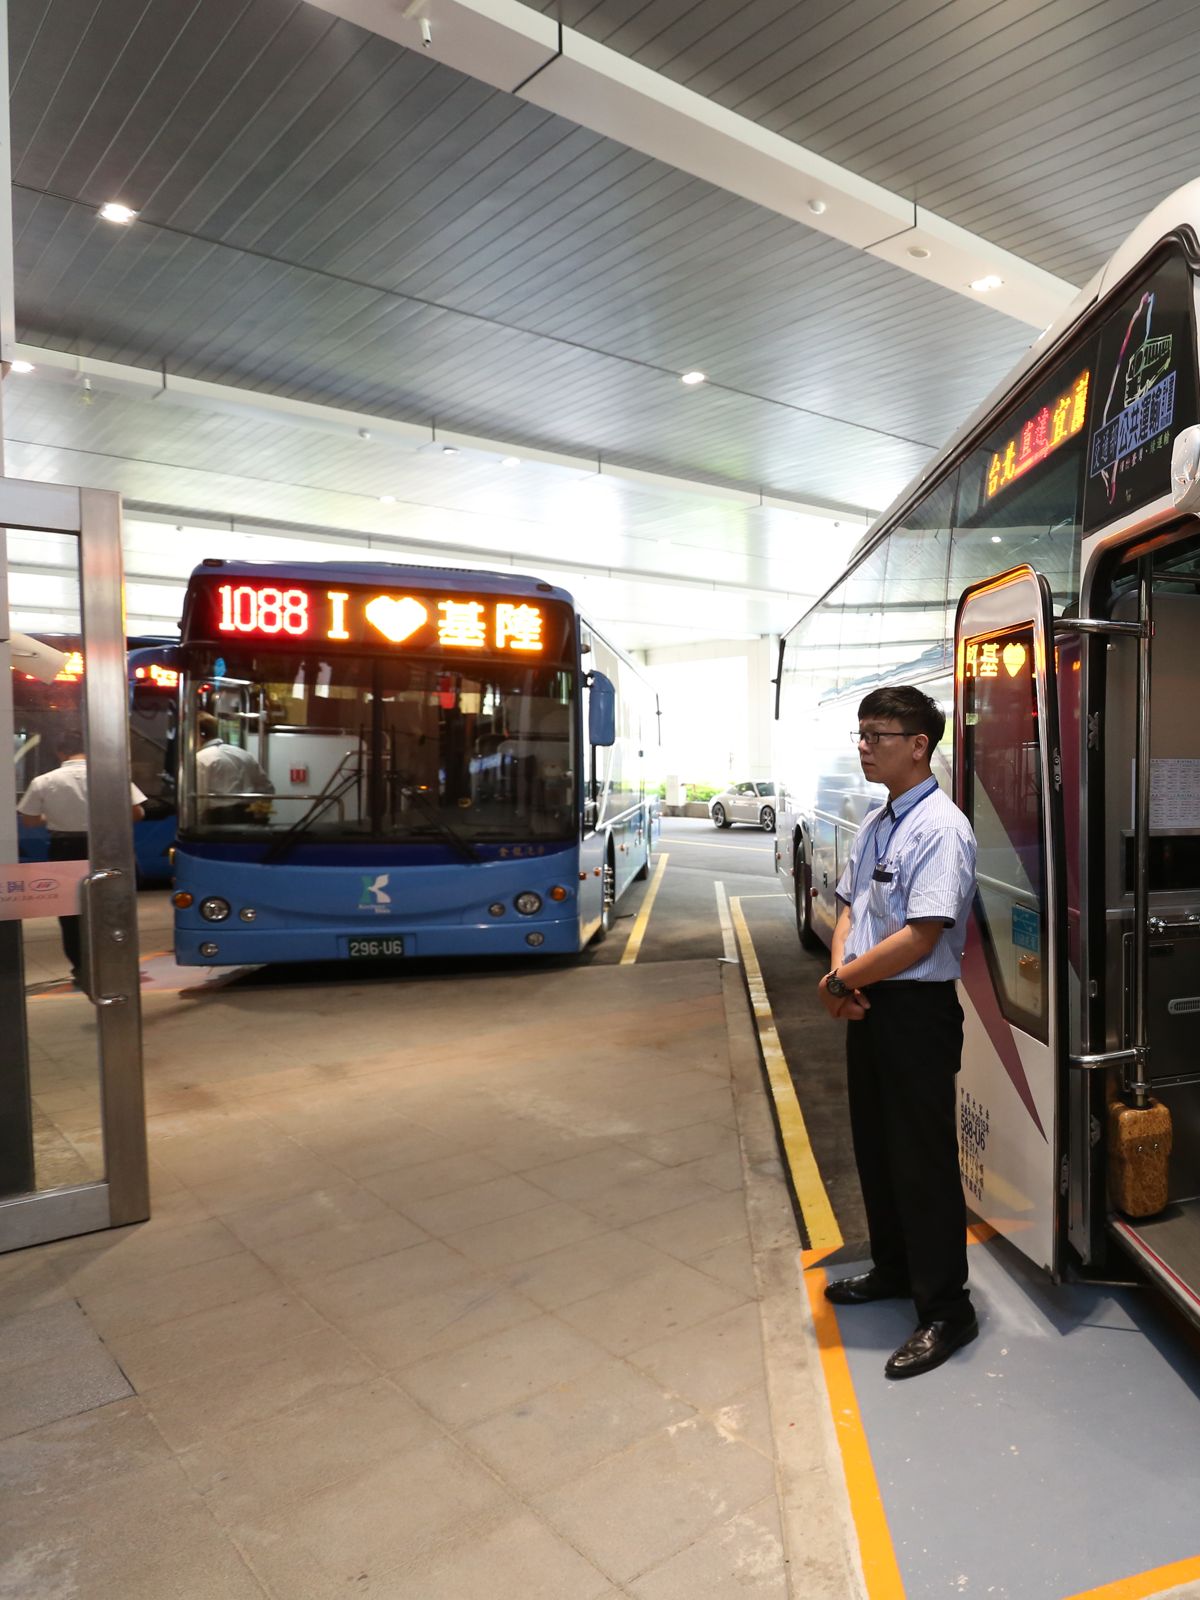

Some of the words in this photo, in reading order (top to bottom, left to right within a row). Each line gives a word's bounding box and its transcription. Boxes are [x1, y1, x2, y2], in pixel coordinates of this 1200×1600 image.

[218, 585, 309, 635] 1088
[327, 591, 349, 639] I
[437, 600, 543, 650] 基隆
[350, 941, 402, 956] 296-U6
